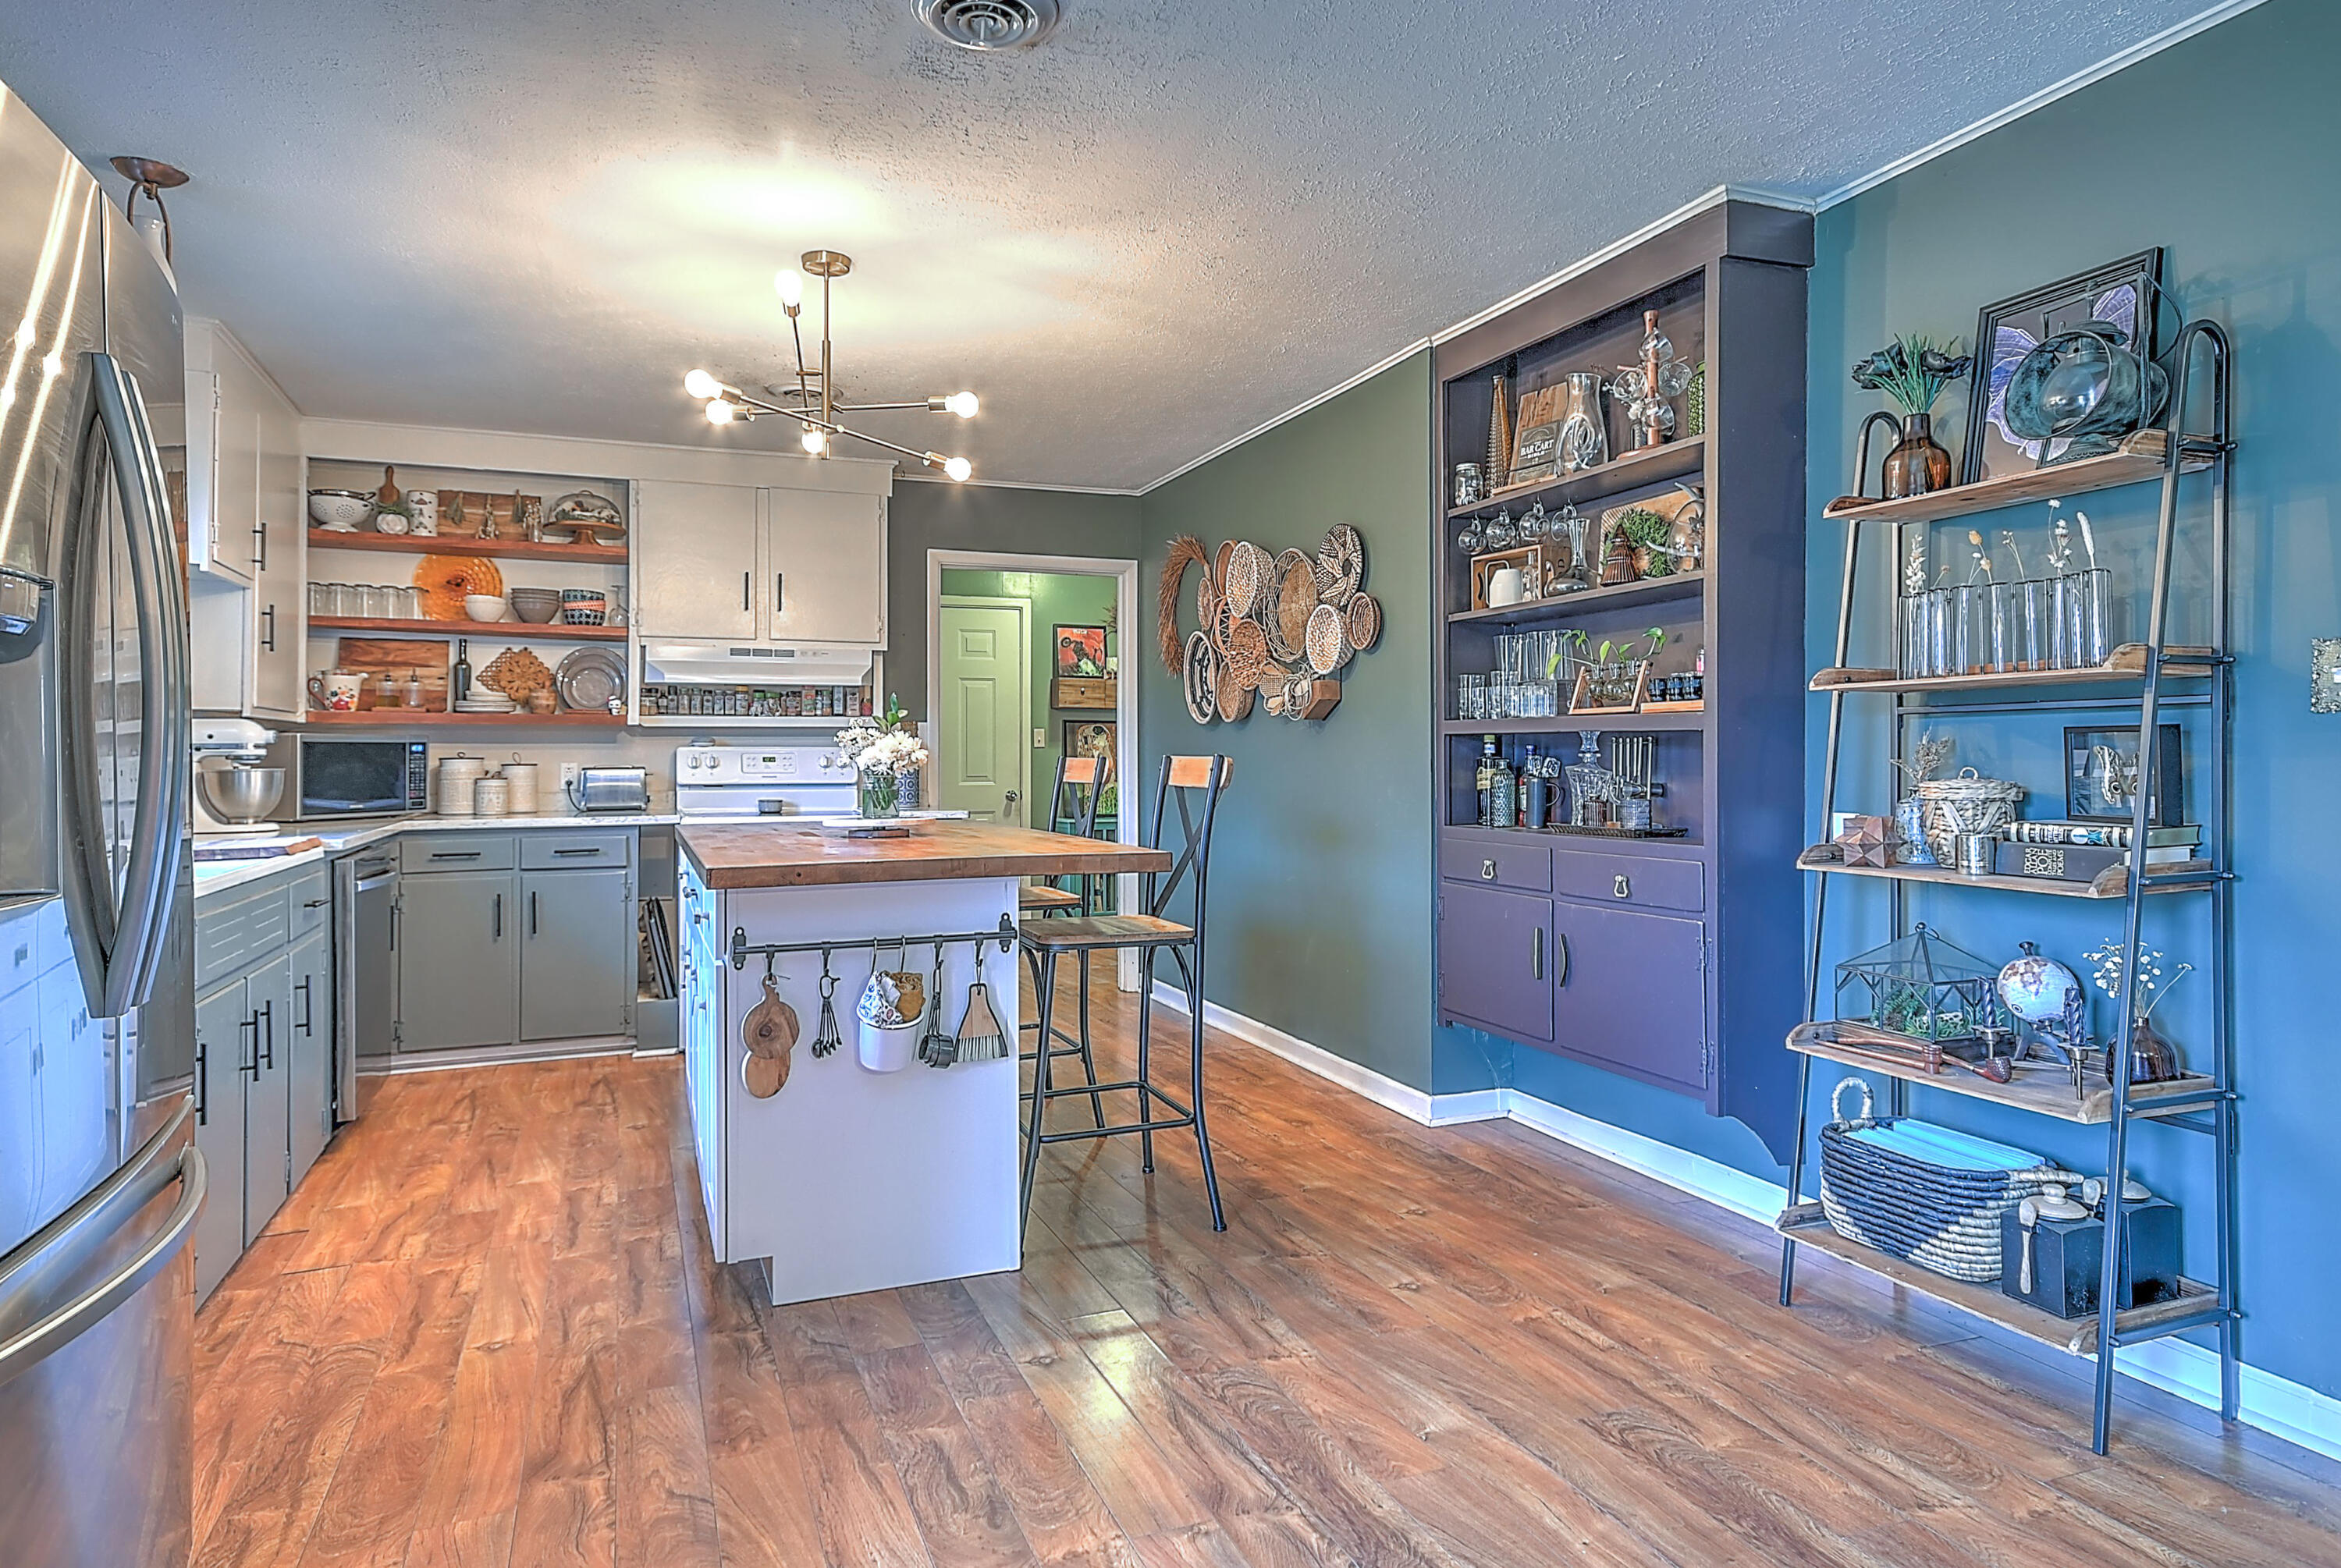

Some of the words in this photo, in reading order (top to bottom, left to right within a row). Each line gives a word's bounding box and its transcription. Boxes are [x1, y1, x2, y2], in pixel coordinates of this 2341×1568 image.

[1521, 445, 1534, 456] BAR
[1535, 439, 1554, 452] CART
[2037, 849, 2048, 874] POE
